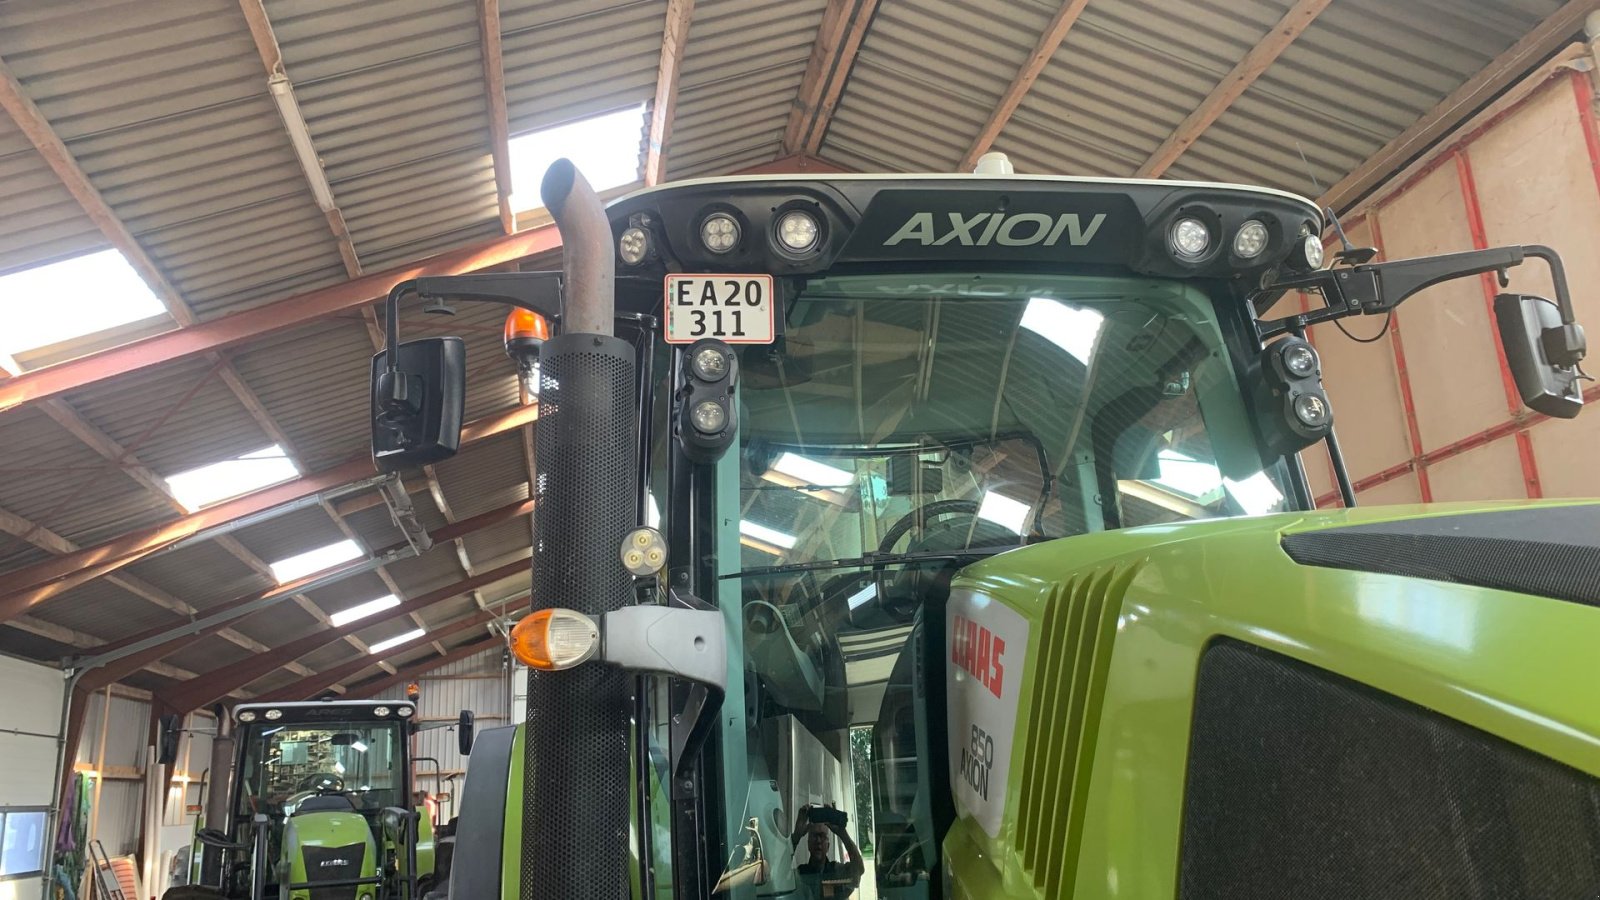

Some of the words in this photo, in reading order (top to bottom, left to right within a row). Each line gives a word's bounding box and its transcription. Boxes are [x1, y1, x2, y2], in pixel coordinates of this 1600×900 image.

[883, 212, 1107, 246] AXION
[677, 281, 762, 306] EA20
[690, 310, 745, 336] 311
[952, 615, 1006, 699] CLAAS
[971, 724, 993, 769] 850
[960, 748, 989, 801] AXION
